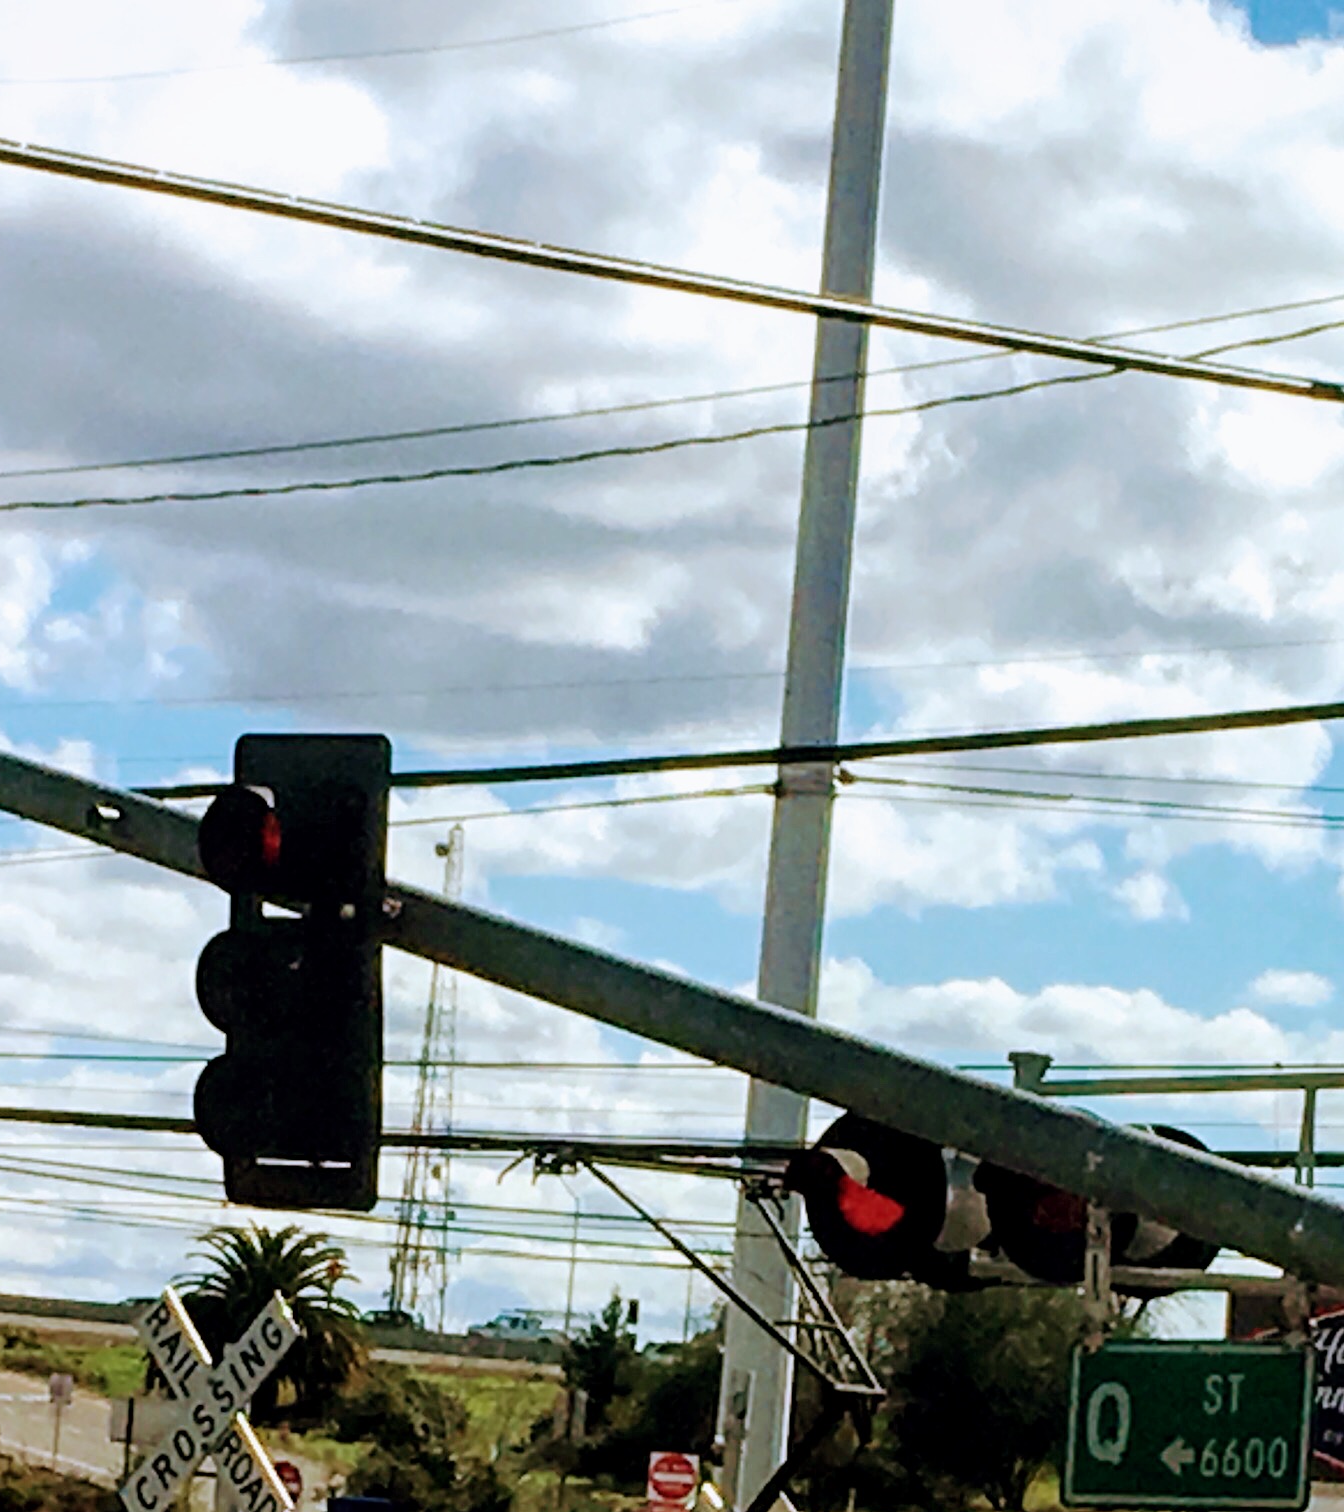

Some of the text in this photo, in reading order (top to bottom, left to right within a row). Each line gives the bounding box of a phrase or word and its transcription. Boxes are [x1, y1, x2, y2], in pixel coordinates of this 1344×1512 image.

[143, 1307, 201, 1398] RAIL
[136, 1315, 284, 1511] CROSSING
[1086, 1372, 1246, 1465] Q ST
[1199, 1436, 1289, 1479] 6600
